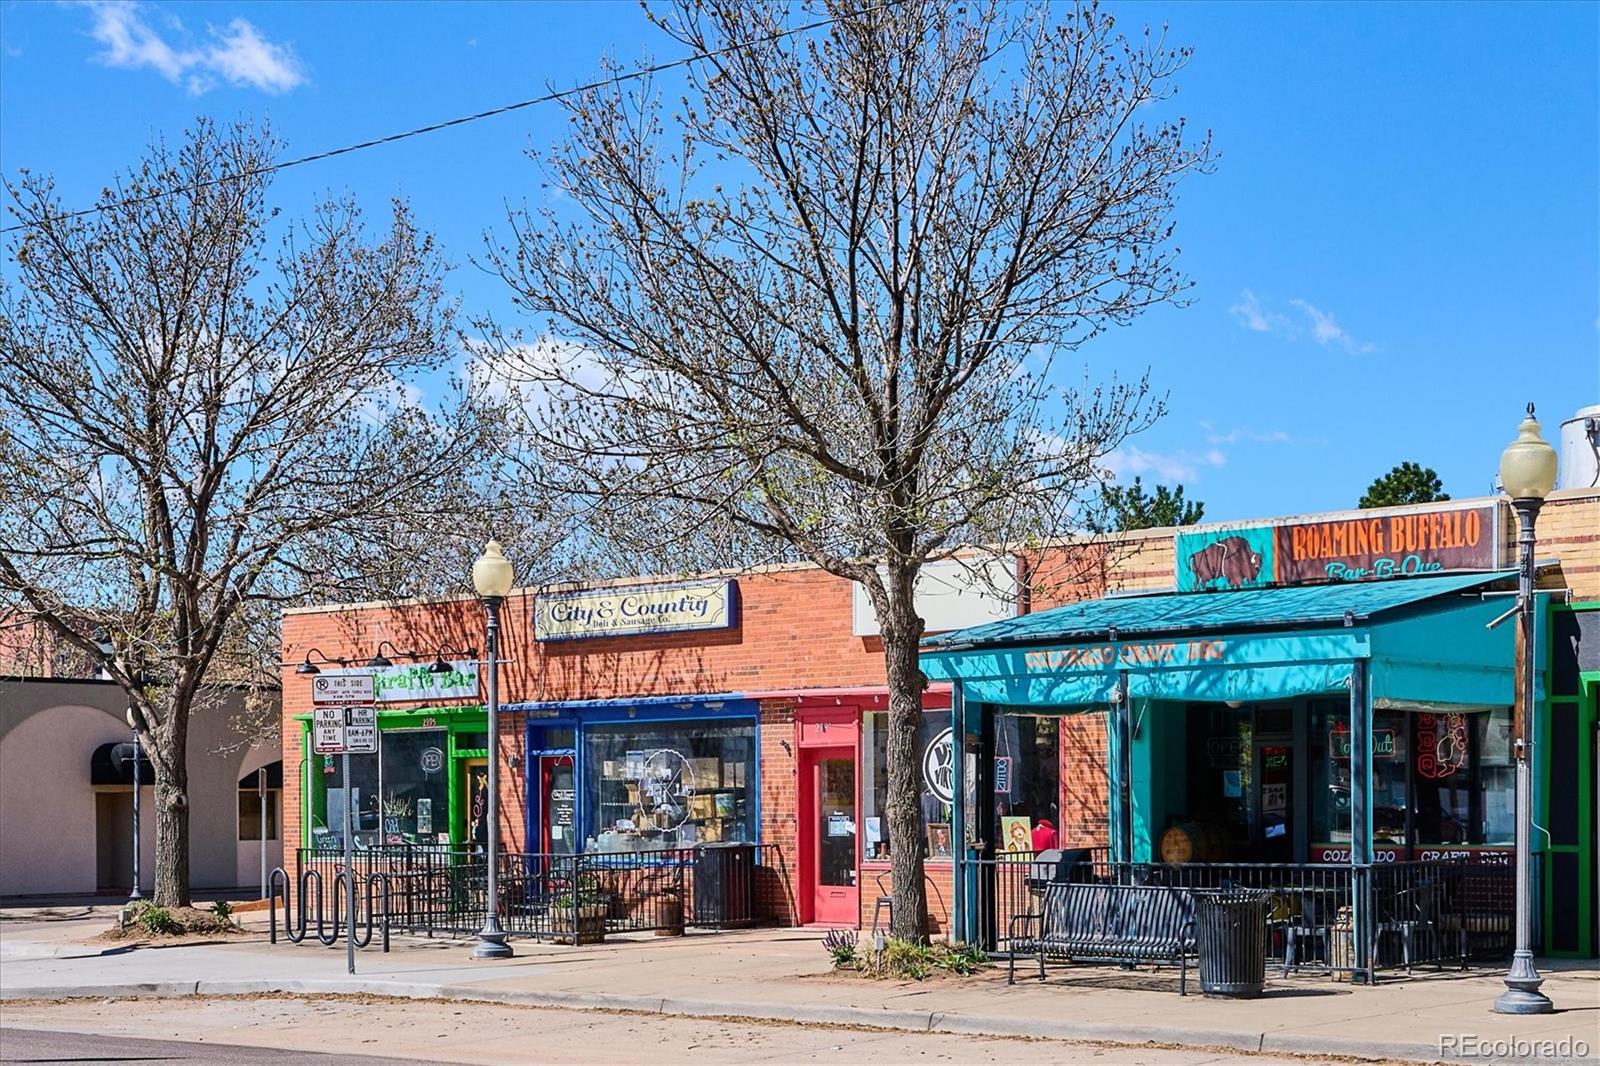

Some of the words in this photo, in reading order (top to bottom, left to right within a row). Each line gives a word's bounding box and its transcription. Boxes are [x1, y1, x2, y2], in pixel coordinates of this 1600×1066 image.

[1292, 517, 1384, 561] ROAMING
[1389, 509, 1481, 553] BUFFALO
[551, 602, 593, 626] City
[597, 599, 615, 619] &
[620, 594, 709, 617] Country
[620, 616, 656, 627] Sausage
[351, 679, 363, 687] SIDE
[323, 710, 335, 719] NO
[316, 720, 342, 728] PARKING
[1322, 850, 1396, 863] COLDO
